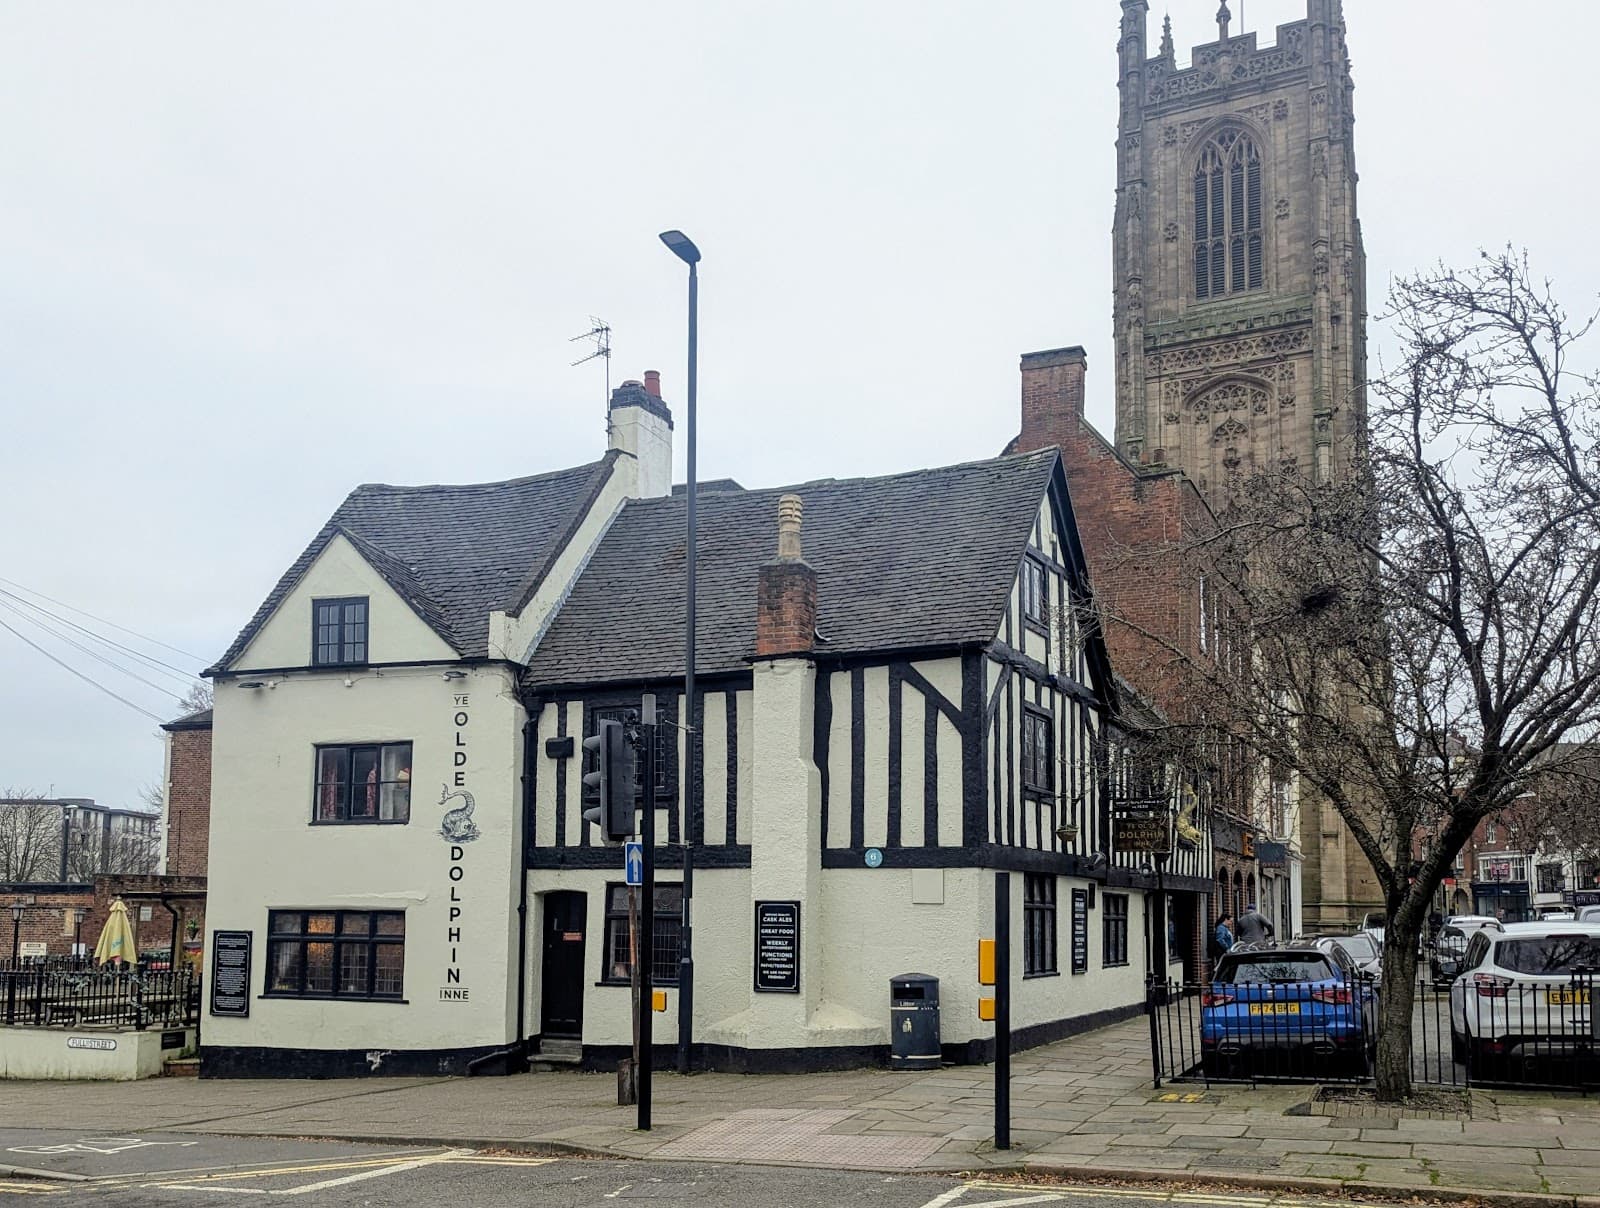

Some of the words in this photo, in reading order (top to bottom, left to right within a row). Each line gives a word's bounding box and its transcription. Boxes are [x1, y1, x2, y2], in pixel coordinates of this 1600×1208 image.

[454, 696, 469, 705] YE
[454, 711, 469, 787] OLDE
[447, 846, 464, 983] DOLPHIN
[439, 989, 469, 1000] INNE
[89, 1040, 112, 1049] STREET
